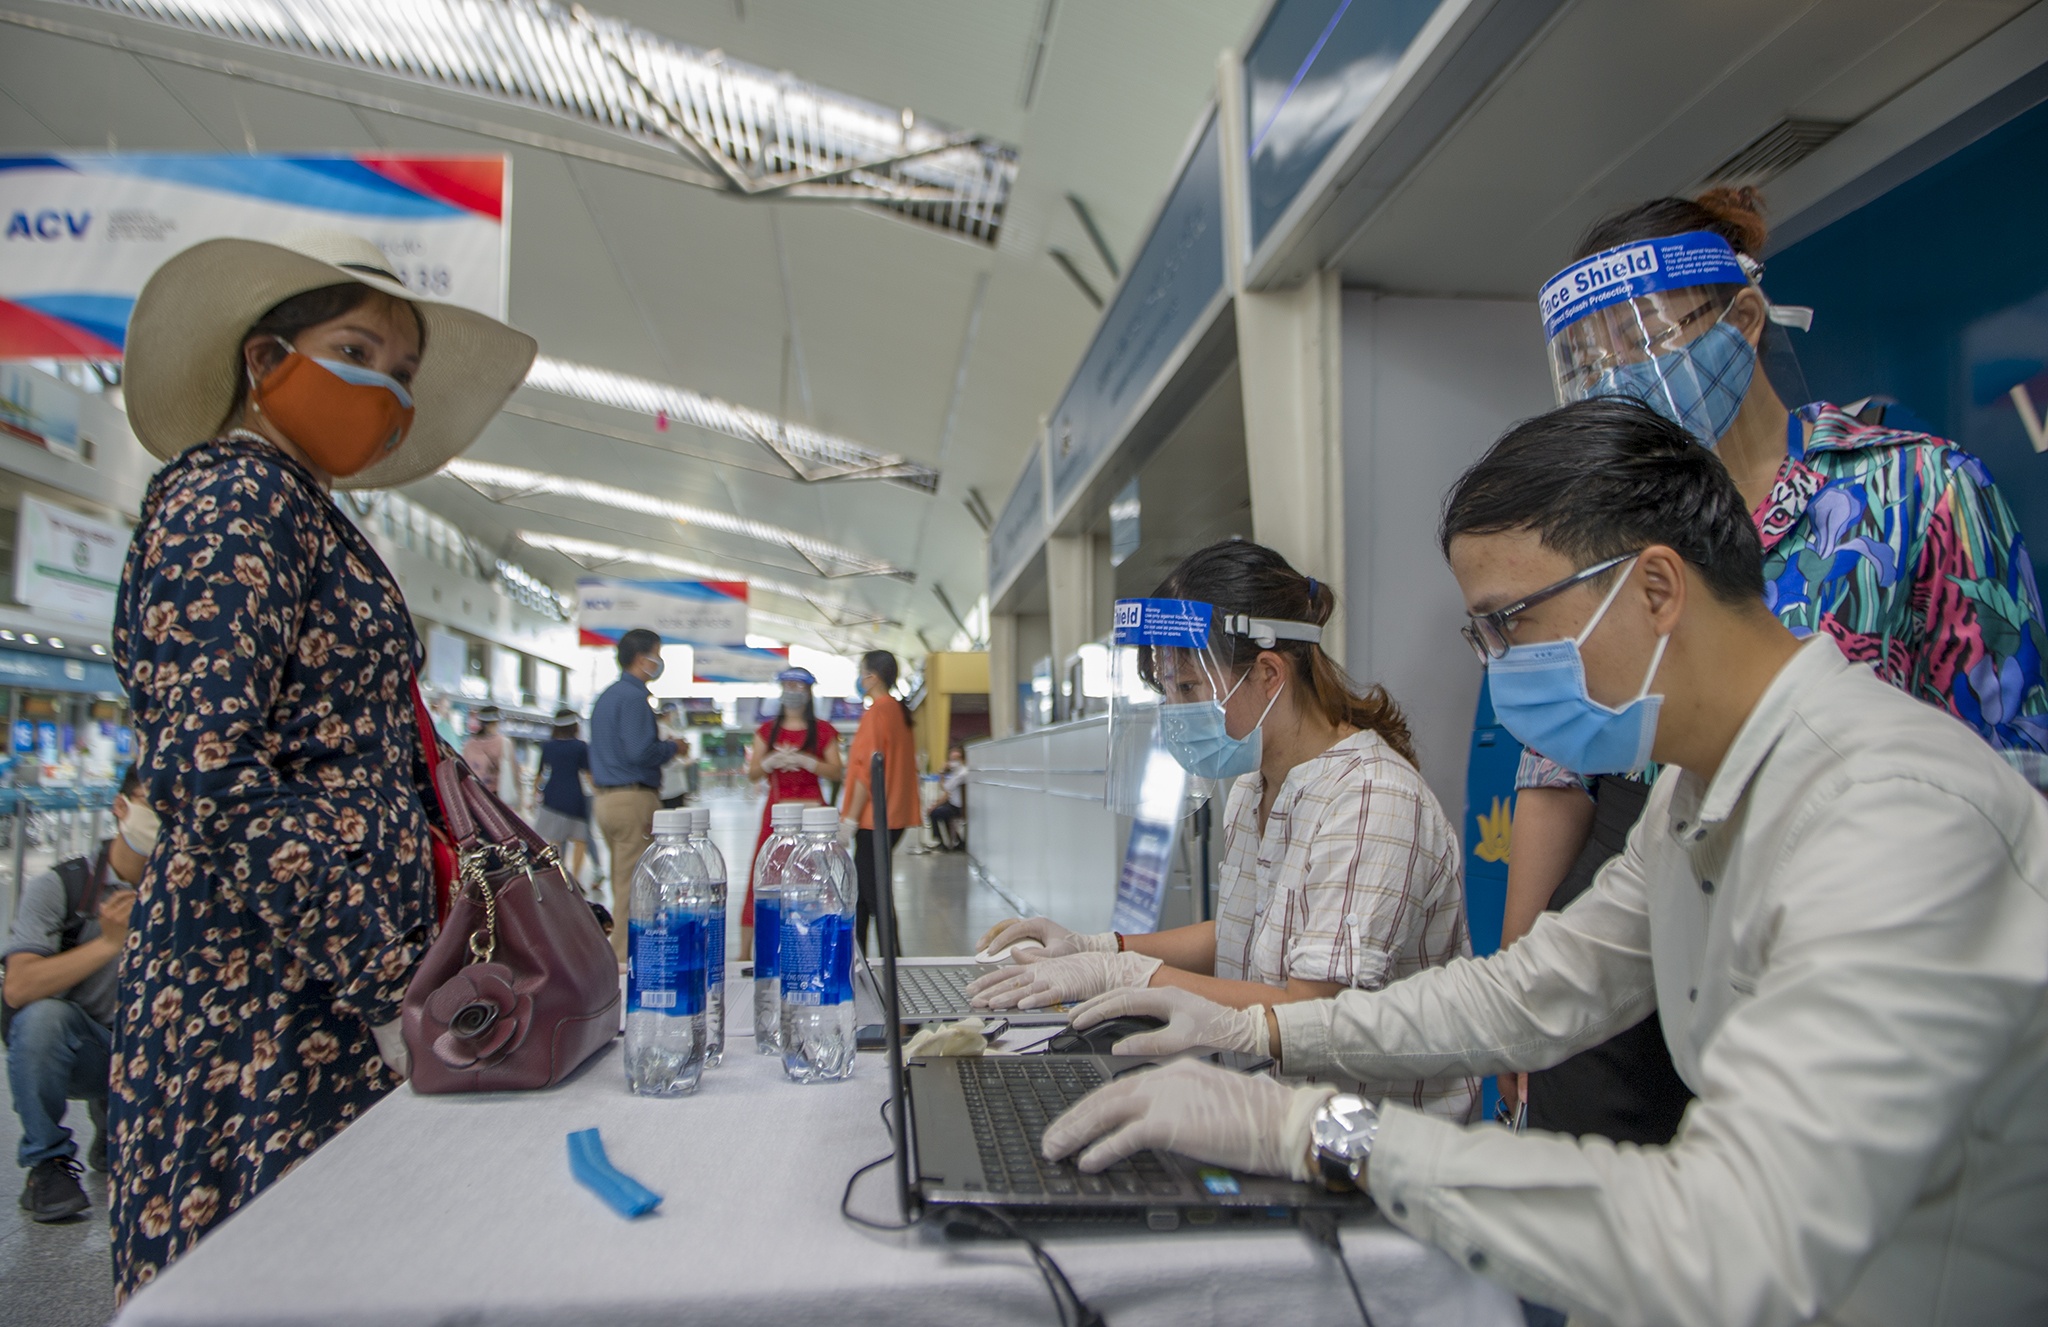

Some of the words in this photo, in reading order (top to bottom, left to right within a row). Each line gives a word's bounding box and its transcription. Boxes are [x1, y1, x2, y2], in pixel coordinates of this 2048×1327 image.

[7, 209, 92, 241] ACV
[1574, 249, 1652, 294] Shield
[1589, 283, 1633, 304] Protection
